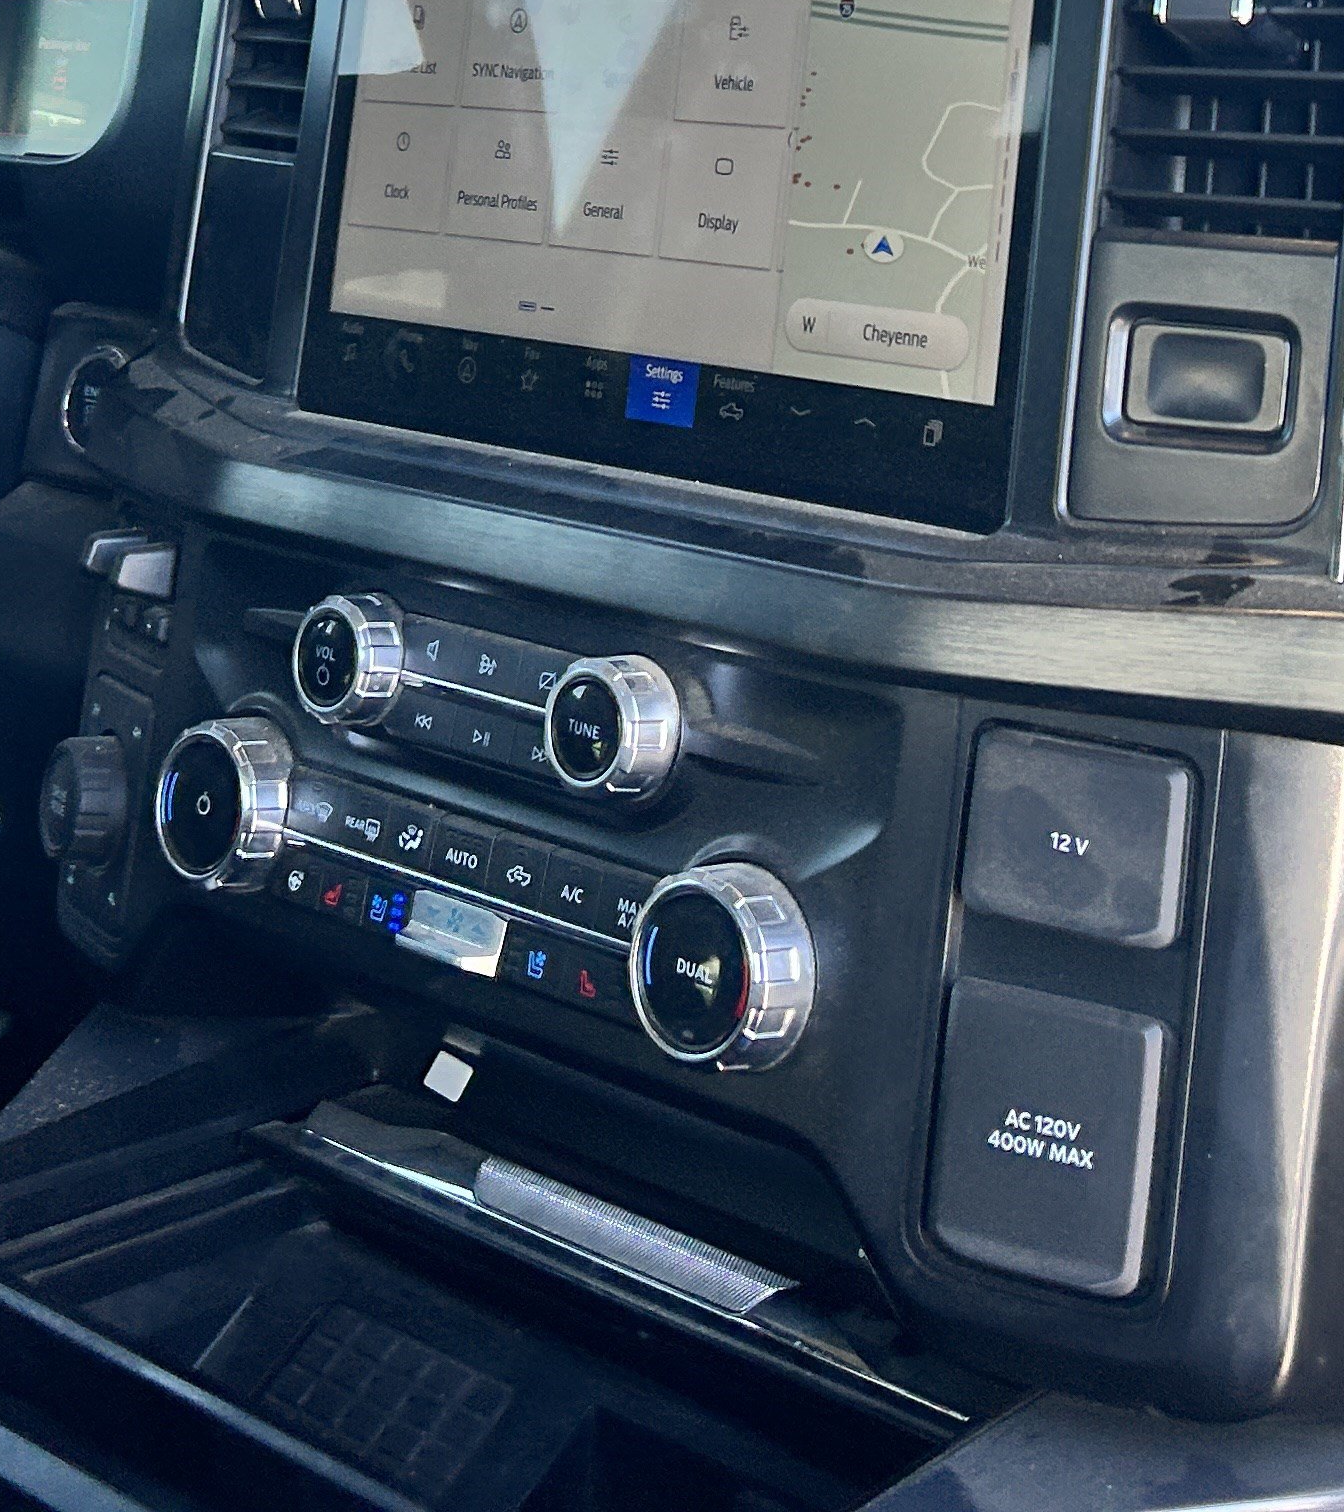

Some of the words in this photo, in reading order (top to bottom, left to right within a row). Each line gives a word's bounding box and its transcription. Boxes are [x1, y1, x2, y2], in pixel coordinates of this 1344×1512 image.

[472, 62, 499, 78] SYNC
[500, 65, 554, 83] Navigation
[714, 73, 754, 92] Vehicle
[385, 183, 409, 199] Clock
[457, 190, 499, 209] Personal
[501, 194, 537, 212] Profiles
[583, 201, 624, 220] General
[698, 212, 738, 235] Display
[968, 255, 987, 270] We
[802, 315, 816, 334] W
[863, 323, 928, 348] Cheyenne
[645, 363, 683, 384] Settings
[315, 644, 336, 662] VOL
[568, 718, 601, 740] TUNE
[345, 815, 366, 831] REAR
[1050, 831, 1072, 854] 12
[1075, 836, 1090, 856] V
[445, 847, 478, 870] AUTO
[560, 884, 584, 904] A/C
[676, 957, 713, 985] DUAL
[1005, 1108, 1031, 1131] AC
[1034, 1114, 1081, 1141] 120V
[987, 1130, 1046, 1159] 400W
[1049, 1142, 1094, 1170] MAX
